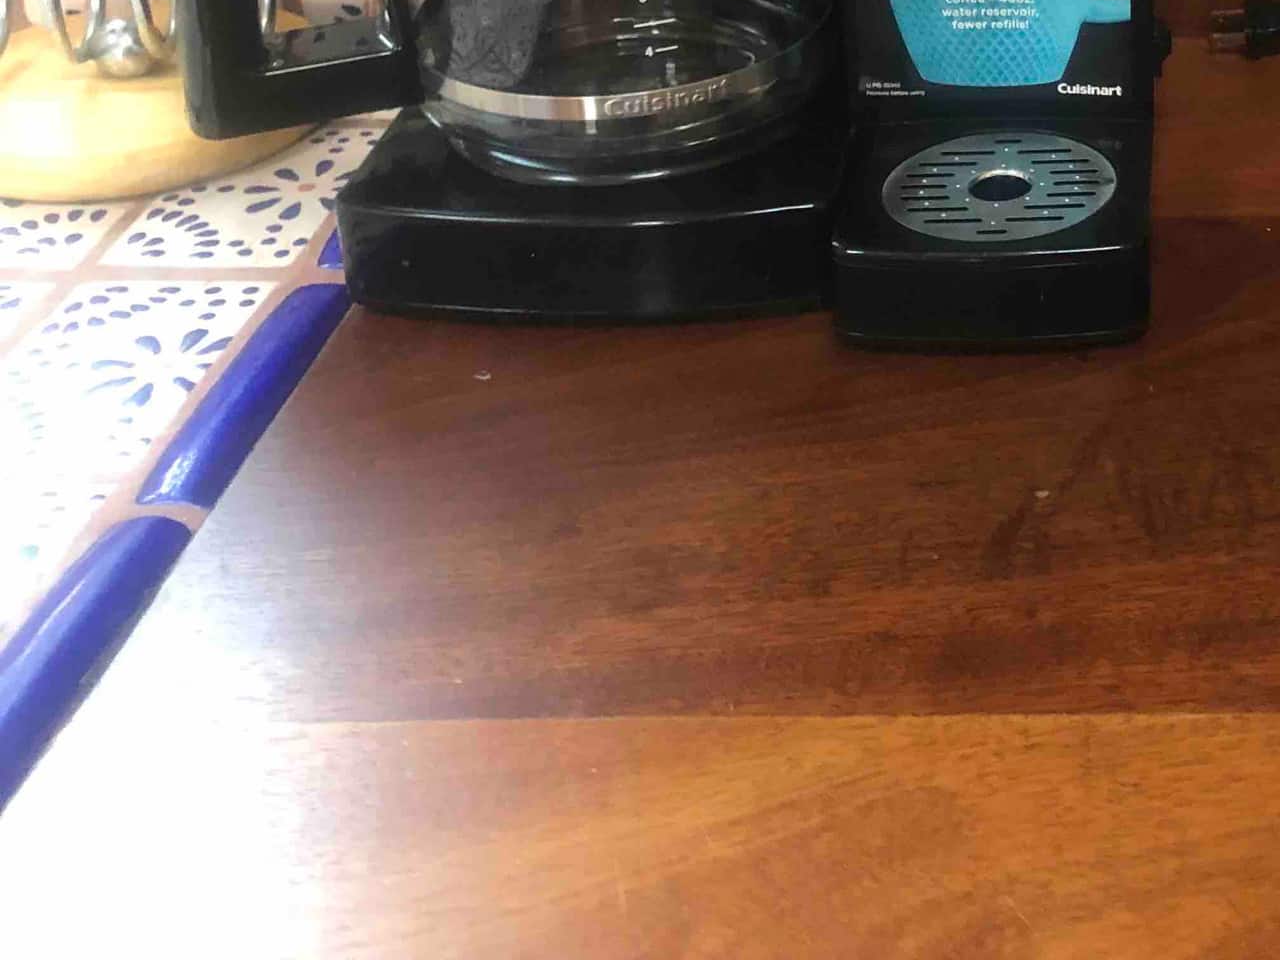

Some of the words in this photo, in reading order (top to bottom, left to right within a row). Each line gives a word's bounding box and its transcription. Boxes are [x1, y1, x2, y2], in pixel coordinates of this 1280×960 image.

[942, 7, 978, 17] water
[951, 20, 987, 30] fewer
[644, 45, 654, 57] 4
[1057, 81, 1124, 97] Cuisinart
[603, 78, 727, 117] Cuisinart
